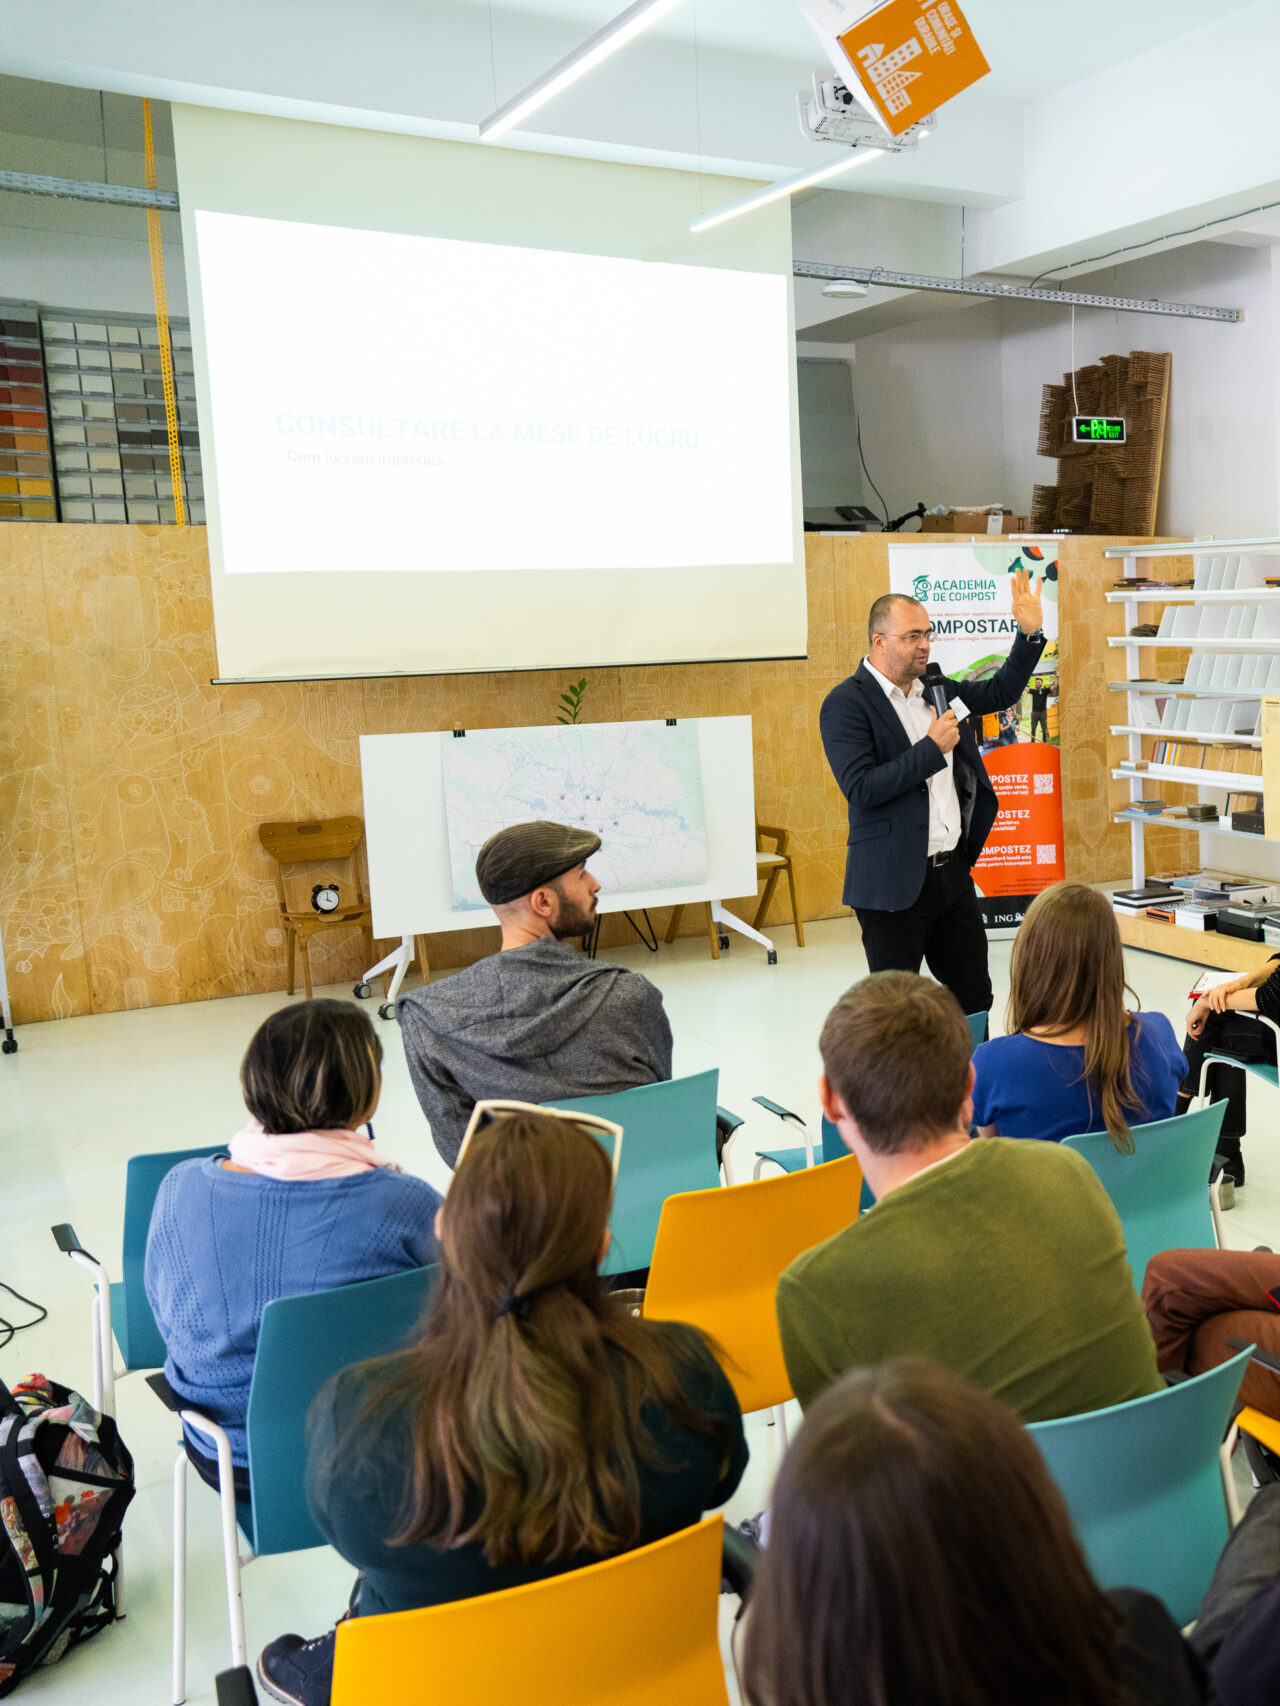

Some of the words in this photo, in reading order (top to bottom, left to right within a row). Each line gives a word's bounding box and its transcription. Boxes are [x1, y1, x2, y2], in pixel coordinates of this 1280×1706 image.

[274, 411, 465, 441] CONSULTARE
[472, 420, 505, 443] LA
[513, 422, 581, 445] MESE
[589, 424, 618, 446] DE
[625, 424, 700, 449] LUCRU
[287, 448, 321, 463] Cum
[933, 579, 997, 591] ACADEMIA
[933, 592, 946, 602] DE
[949, 591, 997, 601] COMPOST
[929, 618, 1019, 634] OMPOSTAR
[988, 774, 1029, 783] POSTEZ
[997, 810, 1030, 819] OSTEZ
[980, 845, 1032, 856] OMPOSTEZ
[994, 914, 1013, 923] ING
